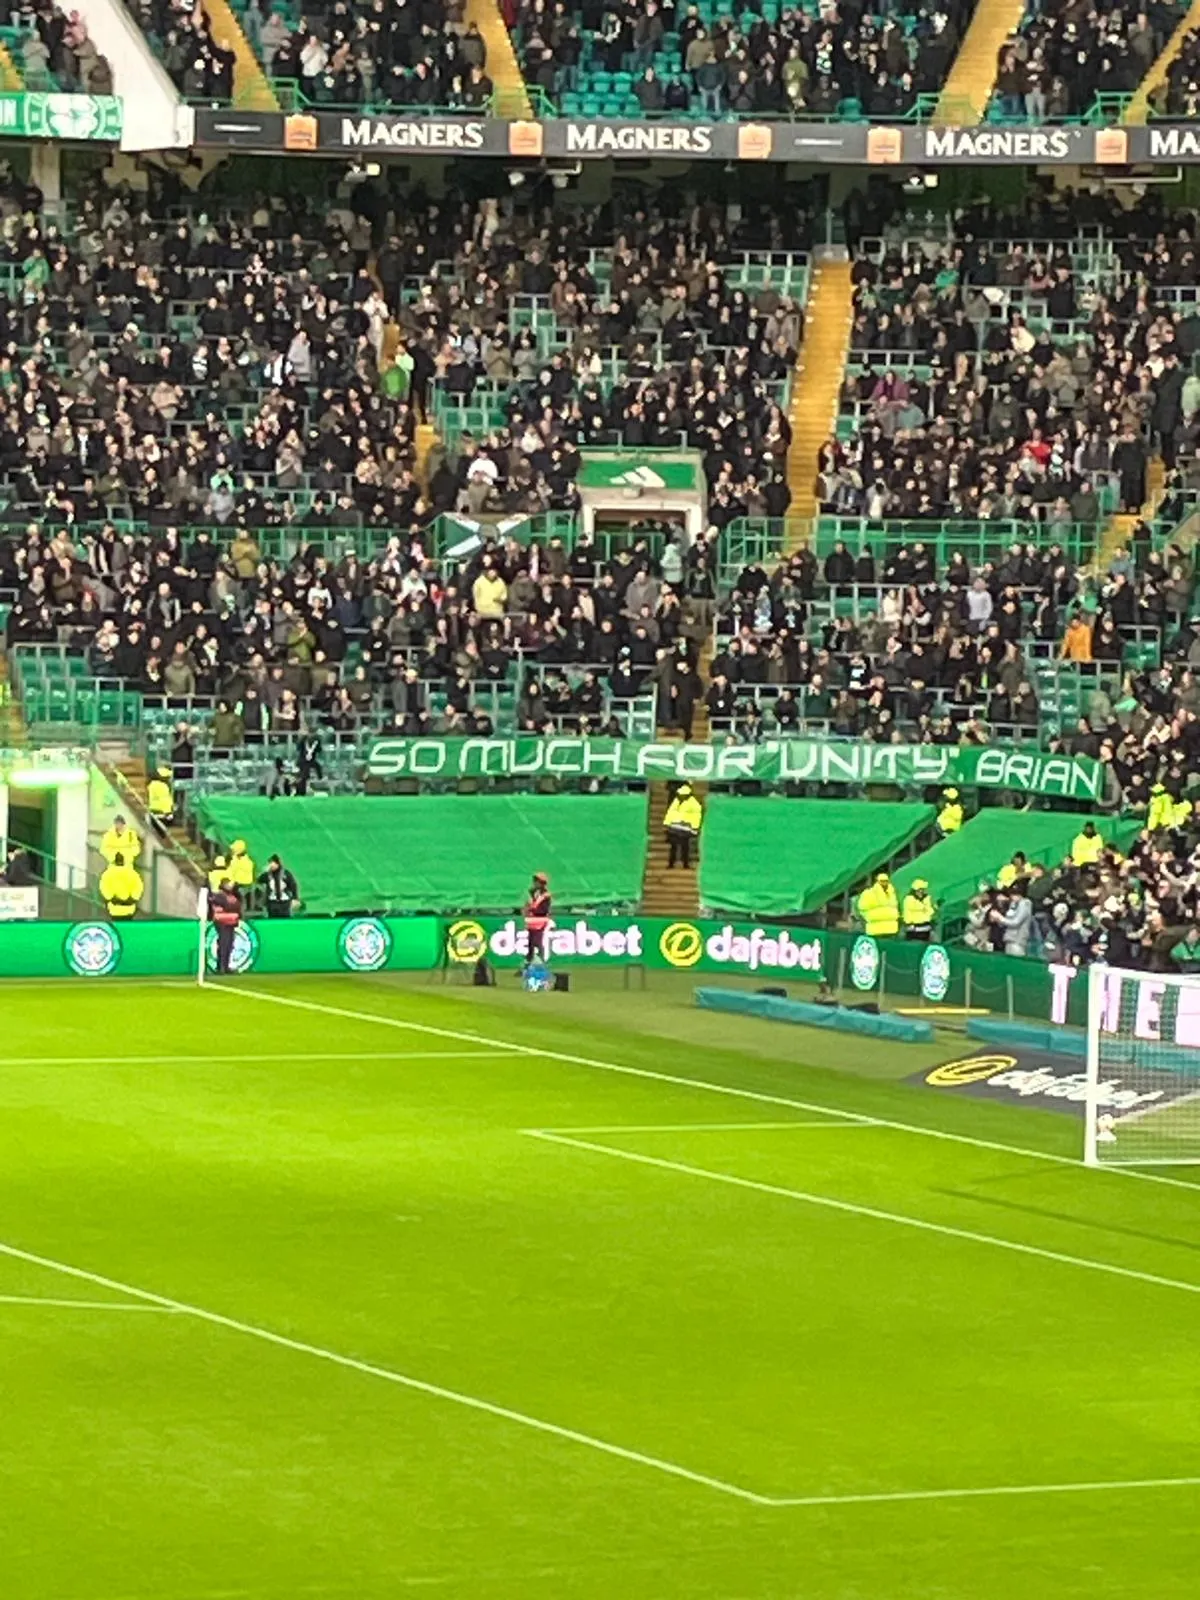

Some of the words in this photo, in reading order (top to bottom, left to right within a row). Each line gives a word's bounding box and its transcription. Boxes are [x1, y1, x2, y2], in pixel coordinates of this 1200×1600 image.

[341, 118, 485, 149] MAGNERS
[566, 122, 712, 152] MAGNERS
[924, 128, 1069, 159] MAGNERS
[368, 740, 446, 775] SO
[459, 740, 622, 776] MUCH
[636, 744, 755, 777] FOR
[975, 749, 1101, 797] BRIAN
[706, 924, 822, 971] dafabet
